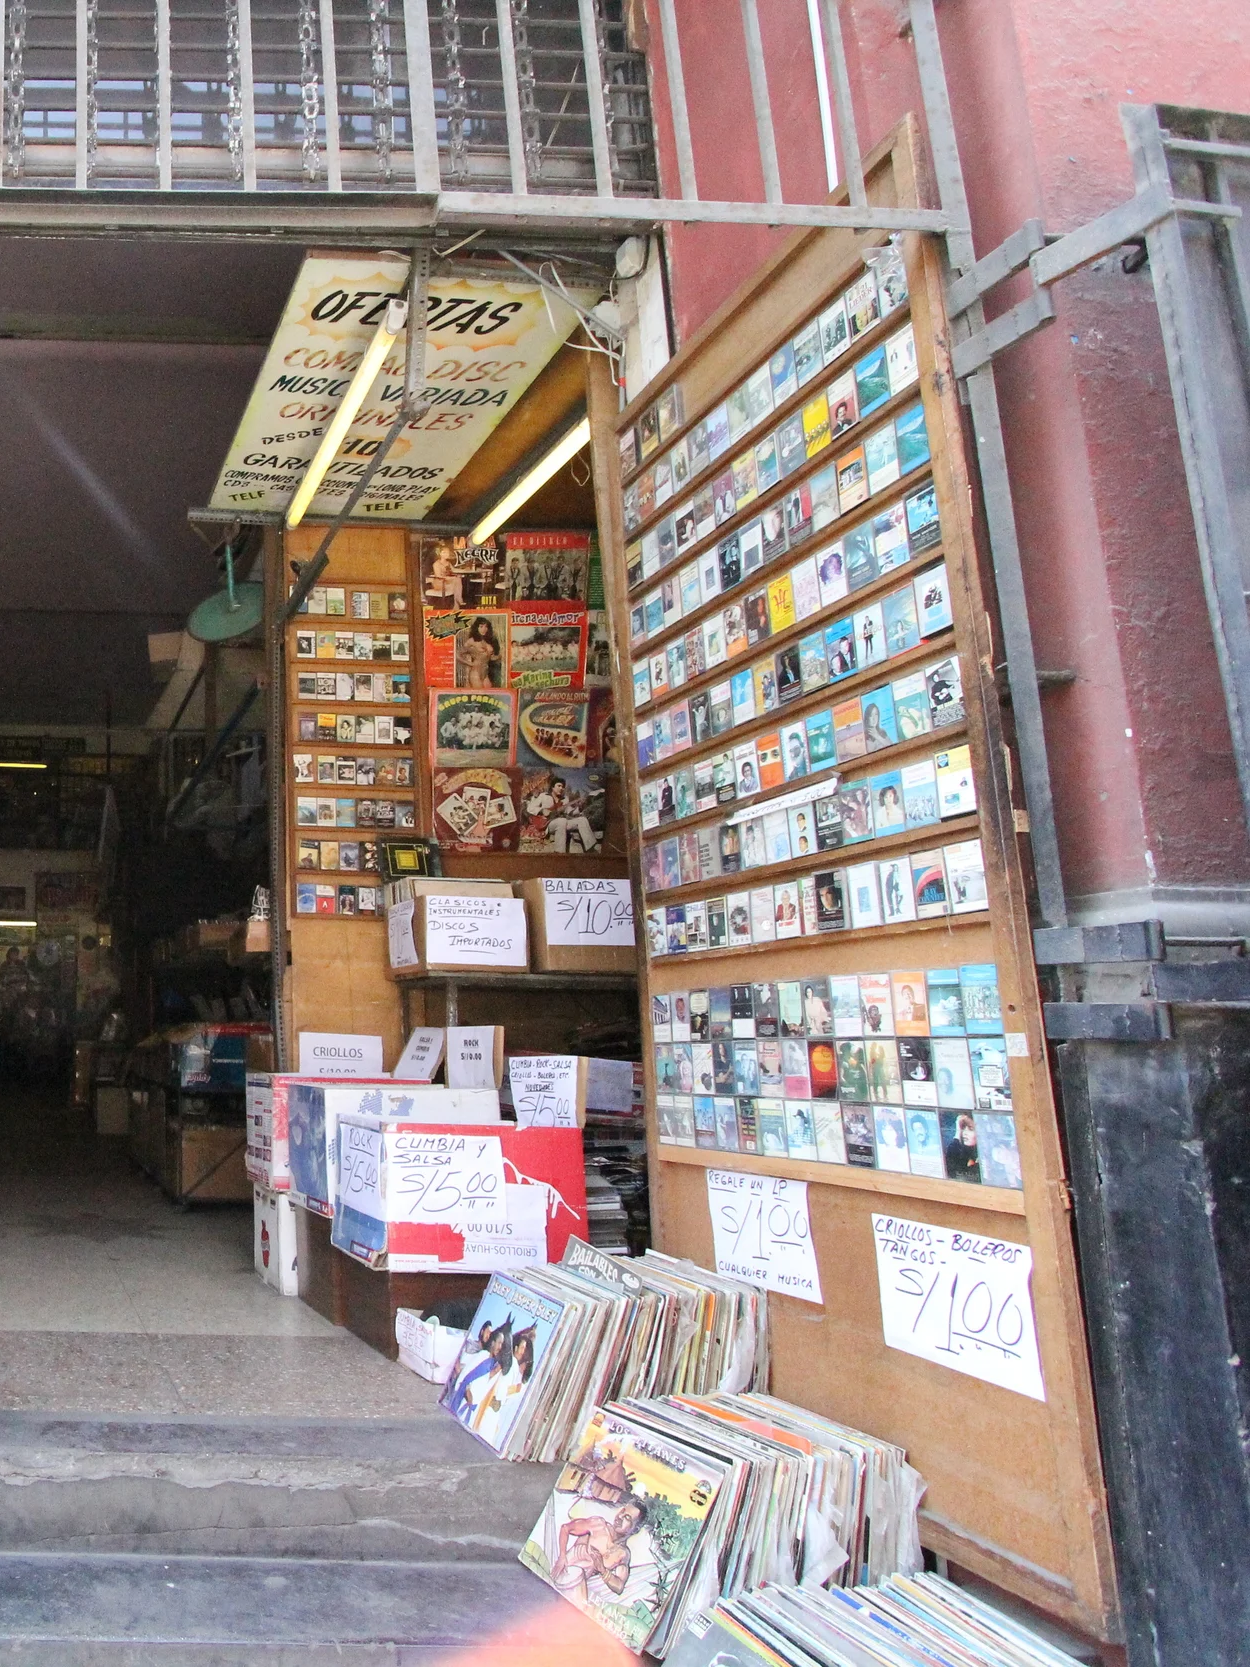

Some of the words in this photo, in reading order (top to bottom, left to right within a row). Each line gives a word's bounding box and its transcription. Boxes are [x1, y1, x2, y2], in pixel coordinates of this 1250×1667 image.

[311, 289, 521, 335] OFETAS
[427, 359, 527, 382] DISC
[261, 427, 323, 445] DESDE
[225, 469, 294, 483] COMPRAMOS
[454, 537, 466, 549] LA
[454, 548, 499, 567] NEGRA
[511, 612, 537, 624] irena
[549, 614, 580, 625] Amor
[522, 669, 552, 684] Marina
[545, 880, 616, 893] BALADAS
[428, 898, 487, 907] CLASICOS
[428, 908, 502, 917] INSTRUMENTALES
[428, 920, 479, 934] DISCOS
[448, 935, 513, 950] IMPORTADOS
[463, 1039, 479, 1047] ROCK
[313, 1046, 363, 1058] CRIOLLOS
[552, 1060, 572, 1070] SALSA
[349, 1127, 373, 1150] ROCK
[395, 1137, 466, 1152] CUMBIA
[393, 1154, 452, 1166] SALSA
[708, 1169, 745, 1189] REGALE
[750, 1178, 762, 1191] UN
[772, 1179, 788, 1197] LP
[875, 1217, 933, 1245] CRIOLLOS
[951, 1233, 1022, 1265] BOLEROS
[881, 1240, 937, 1265] TANGOS
[568, 1244, 618, 1282] BAILABLES
[578, 1265, 596, 1278] CON
[718, 1259, 768, 1281] CUALQUIER
[777, 1274, 813, 1290] MUSICA
[507, 1288, 538, 1317] JASPER
[609, 1420, 629, 1437] LOS
[634, 1436, 686, 1470] TITANES
